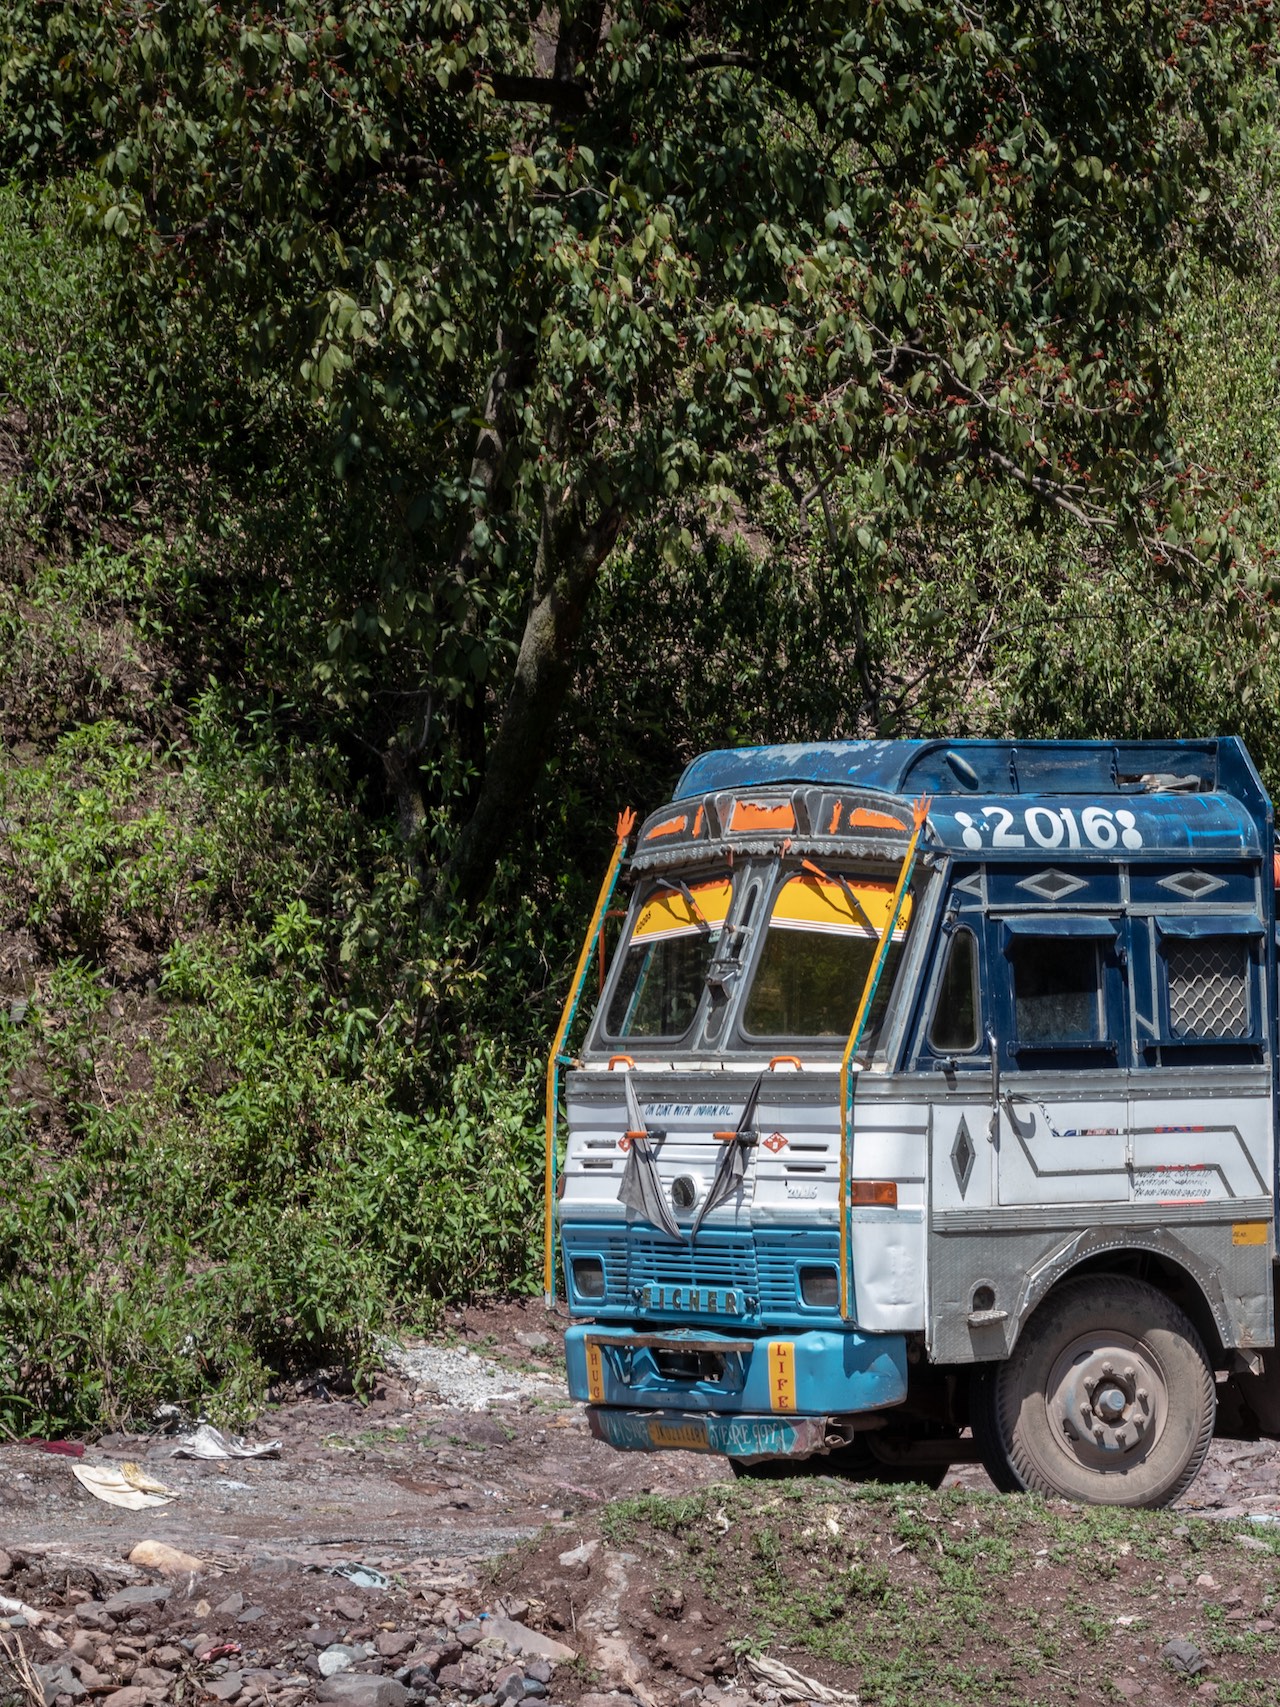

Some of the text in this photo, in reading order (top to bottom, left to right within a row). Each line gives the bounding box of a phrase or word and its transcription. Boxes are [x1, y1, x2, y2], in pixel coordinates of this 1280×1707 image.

[673, 1104, 693, 1116] WITH
[643, 1287, 738, 1315] EICHER
[776, 1343, 789, 1409] LIFE
